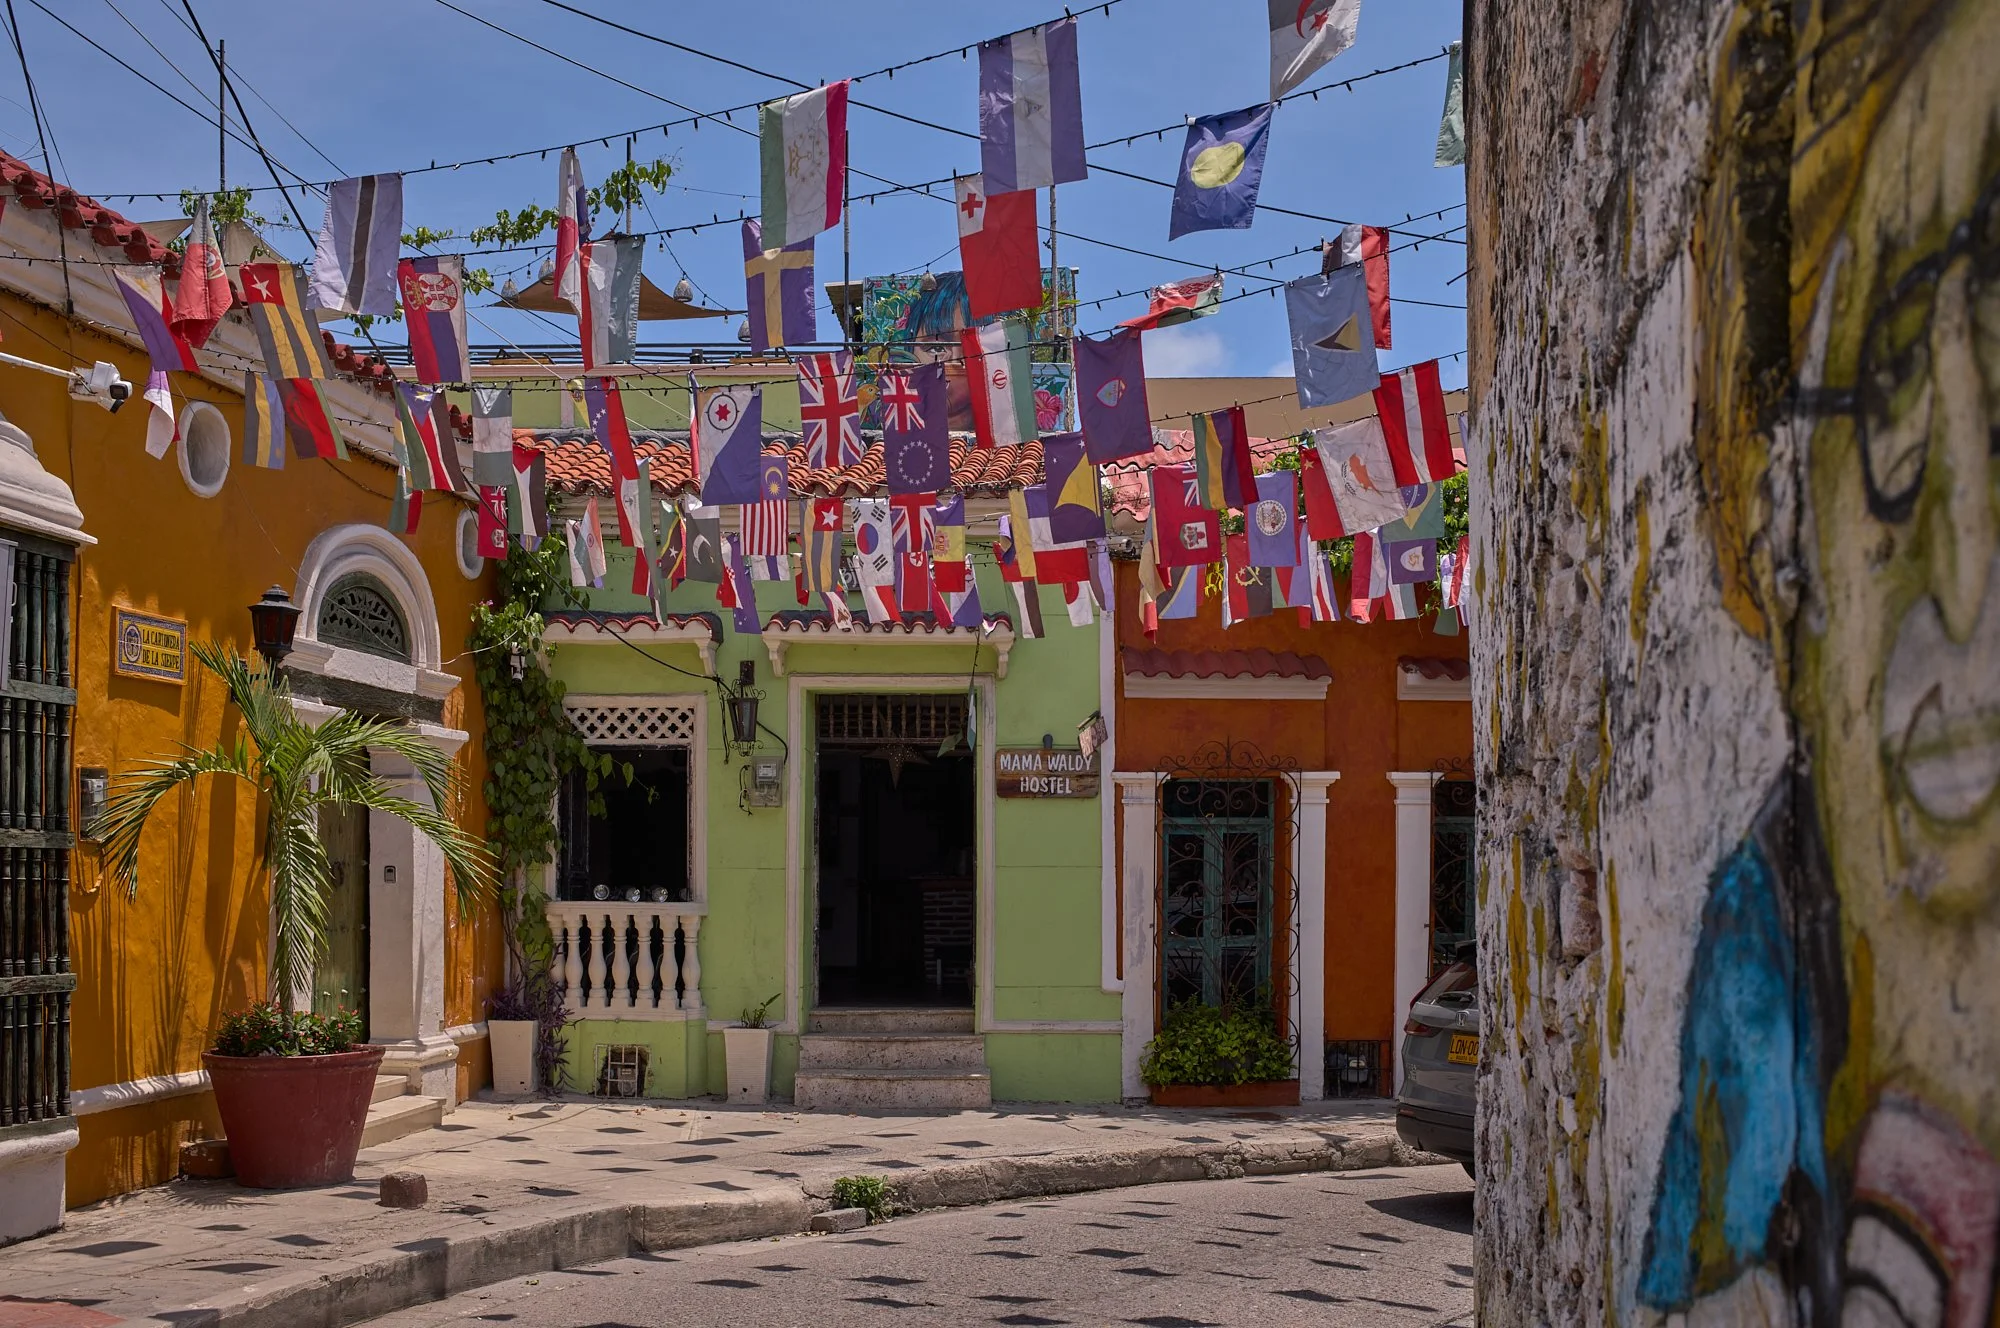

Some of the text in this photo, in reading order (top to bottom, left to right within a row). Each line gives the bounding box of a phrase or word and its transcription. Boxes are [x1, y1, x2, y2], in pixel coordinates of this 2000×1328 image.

[142, 629, 150, 644] LA
[142, 649, 150, 664] DE
[152, 650, 158, 666] LA
[1000, 753, 1093, 771] MAMA WALDY
[1020, 776, 1073, 794] HOSTEL
